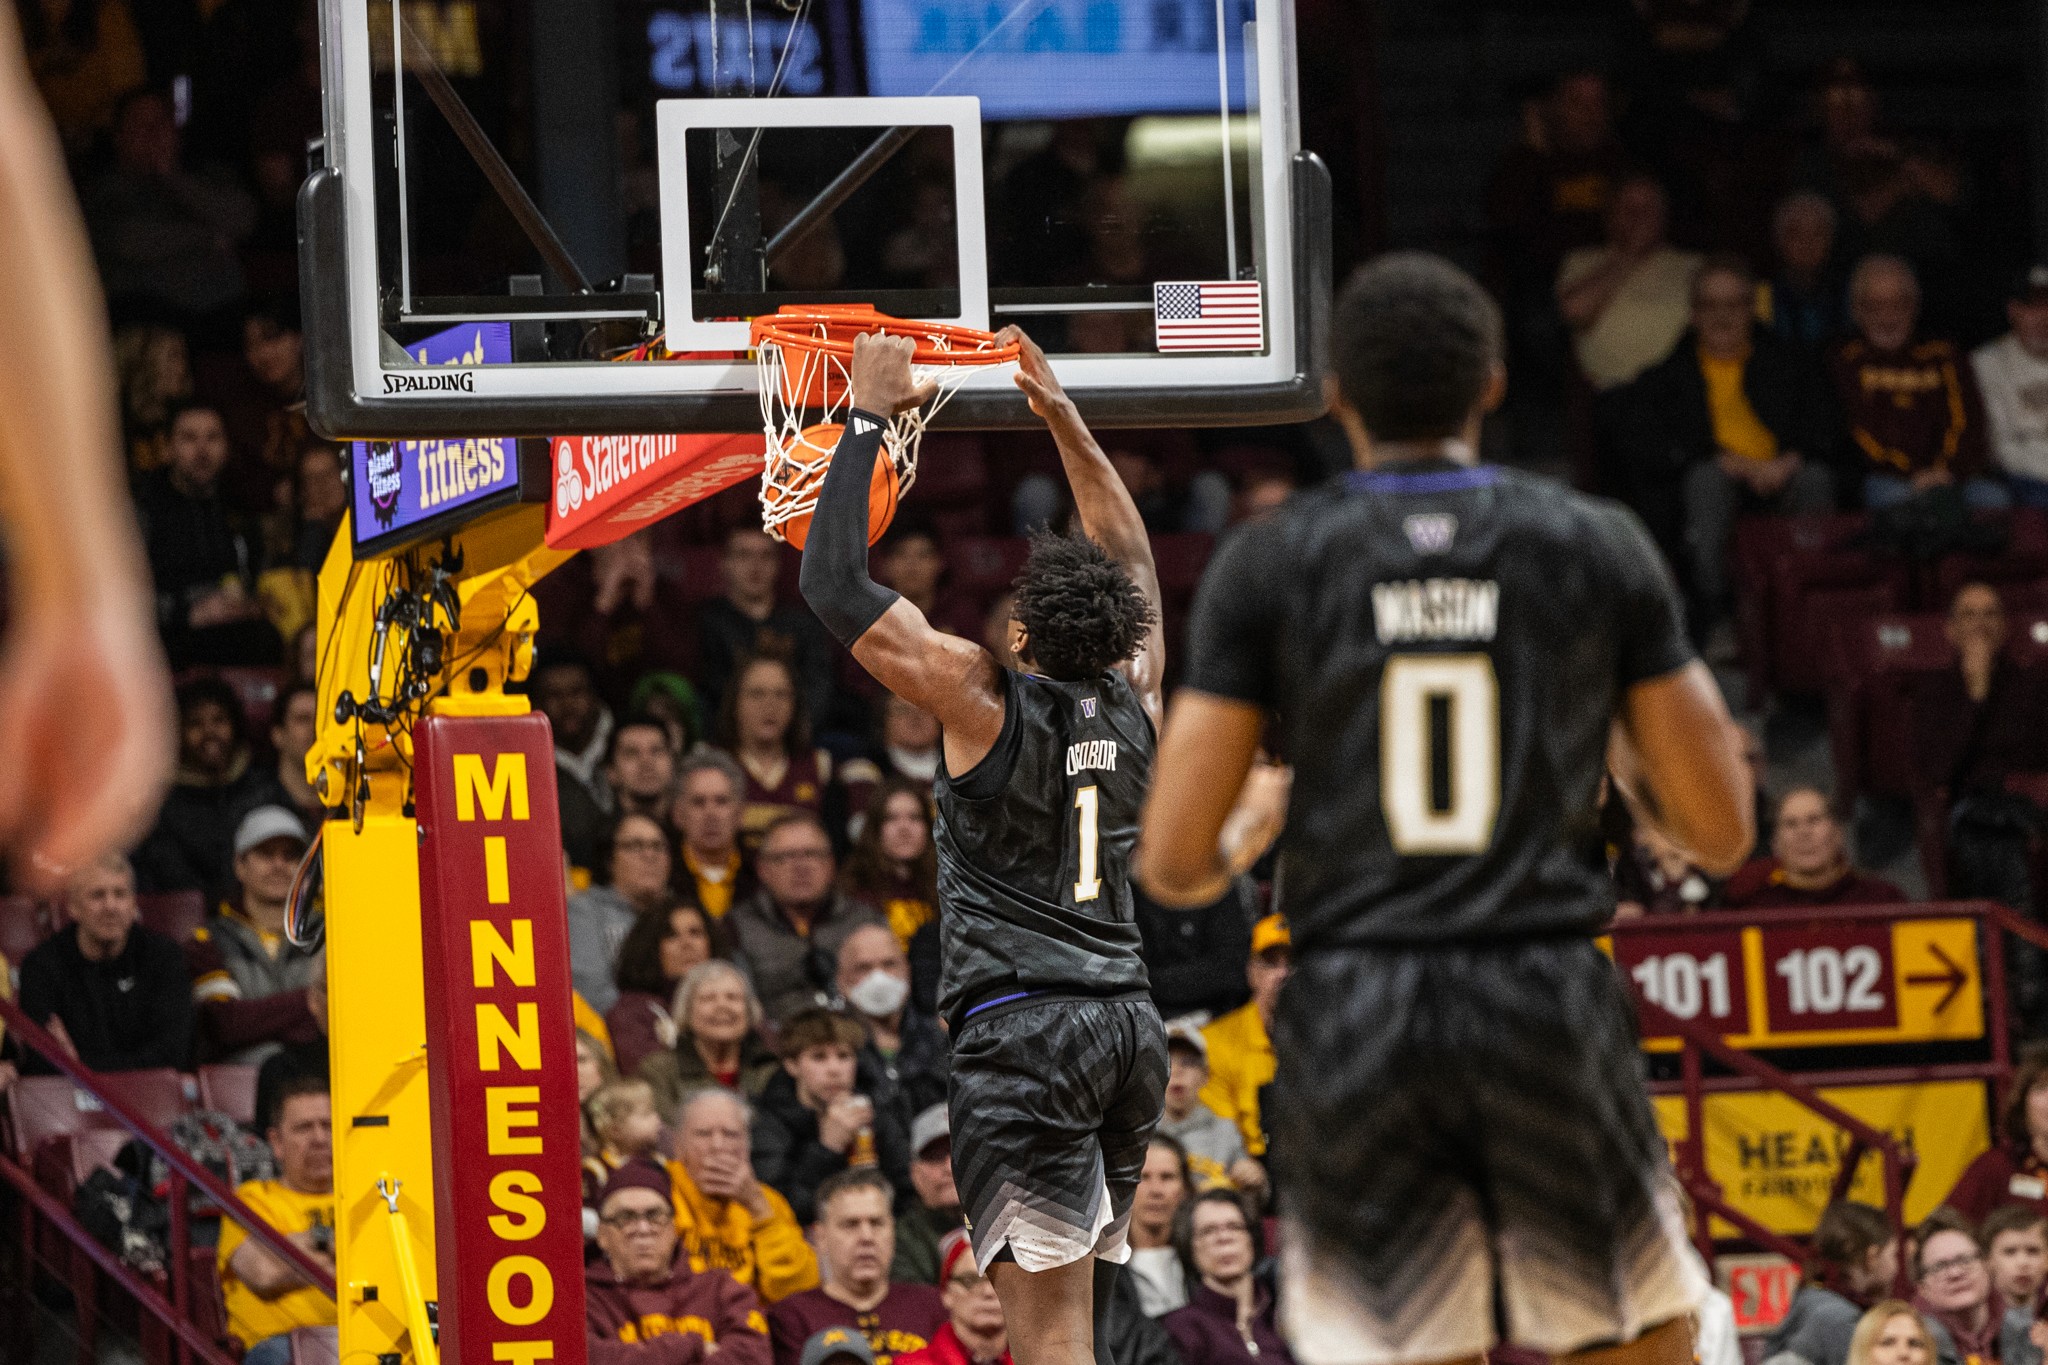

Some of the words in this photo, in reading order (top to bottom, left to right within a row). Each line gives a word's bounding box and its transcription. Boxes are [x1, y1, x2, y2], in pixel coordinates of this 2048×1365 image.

[383, 372, 474, 395] SPALDING
[372, 471, 401, 499] fitness
[1081, 697, 1096, 719] W
[1073, 785, 1102, 902] 1
[1632, 952, 1732, 1020] 101
[1775, 945, 1887, 1014] 102
